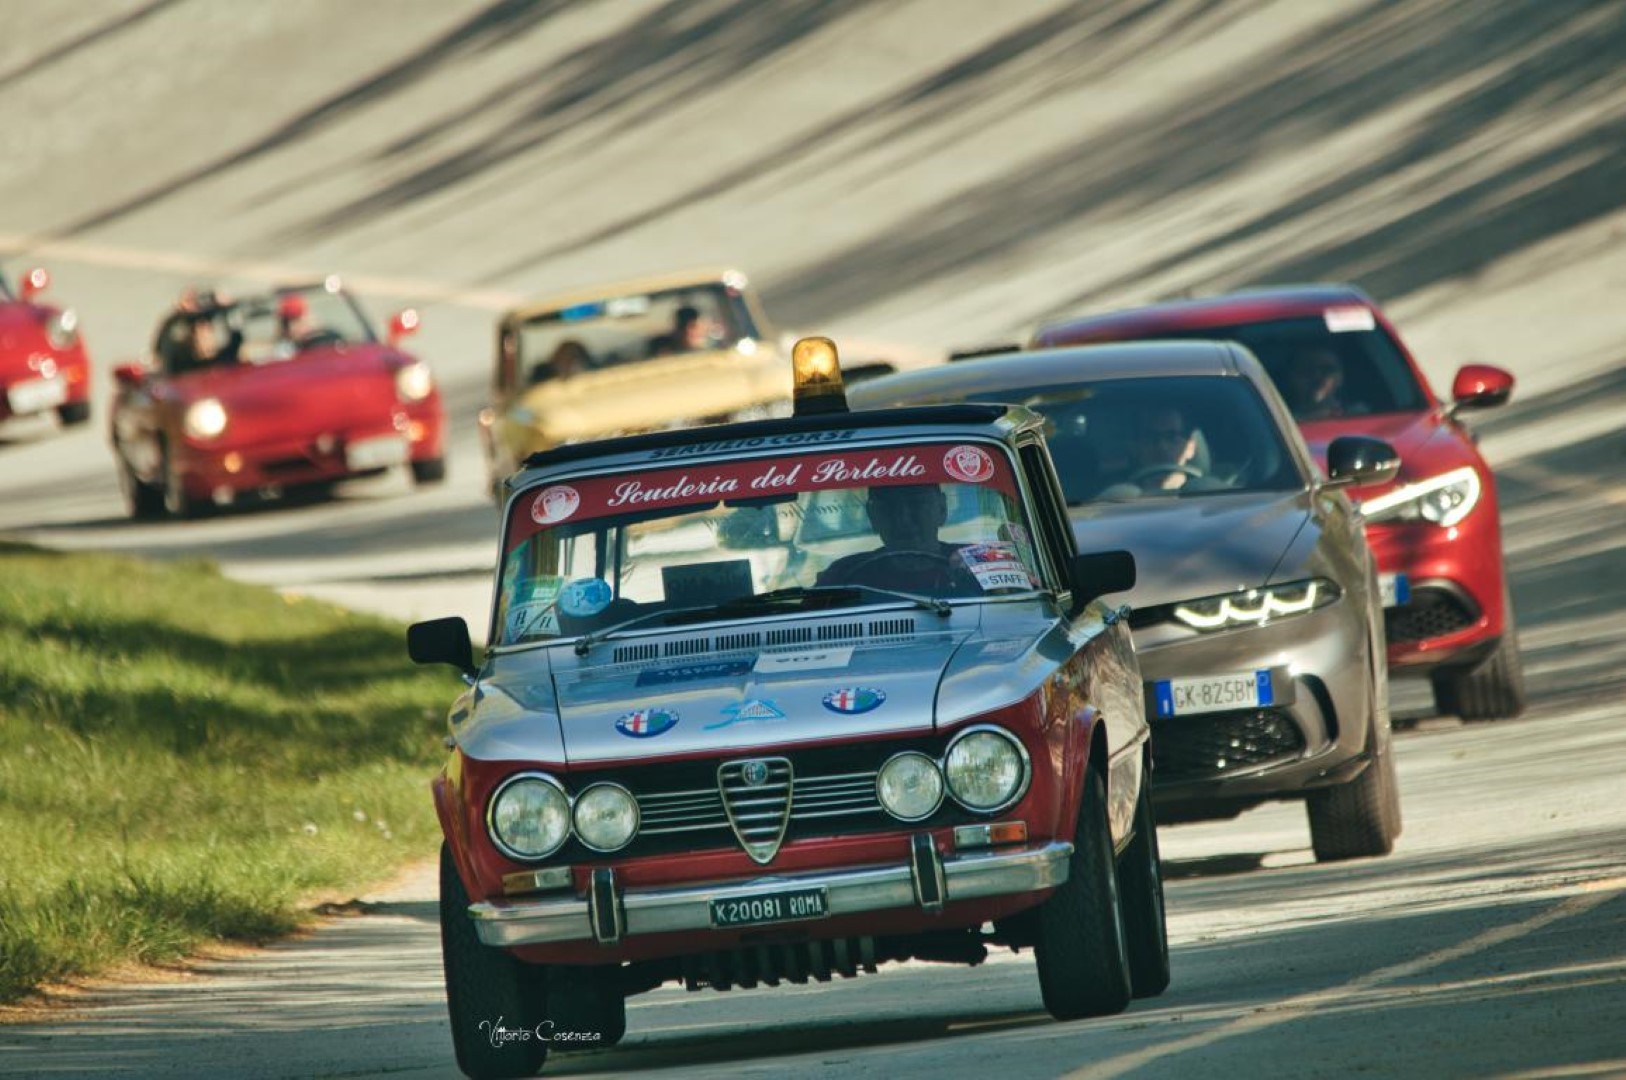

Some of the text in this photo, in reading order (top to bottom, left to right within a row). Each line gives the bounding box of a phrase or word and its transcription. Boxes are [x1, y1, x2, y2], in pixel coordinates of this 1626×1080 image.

[648, 430, 857, 459] SERVIZIO CORSE
[607, 475, 739, 507] Scuderia
[751, 464, 803, 489] del
[811, 456, 926, 483] Portello
[988, 573, 1025, 586] STAFF
[715, 893, 823, 922] K20081 ROMA
